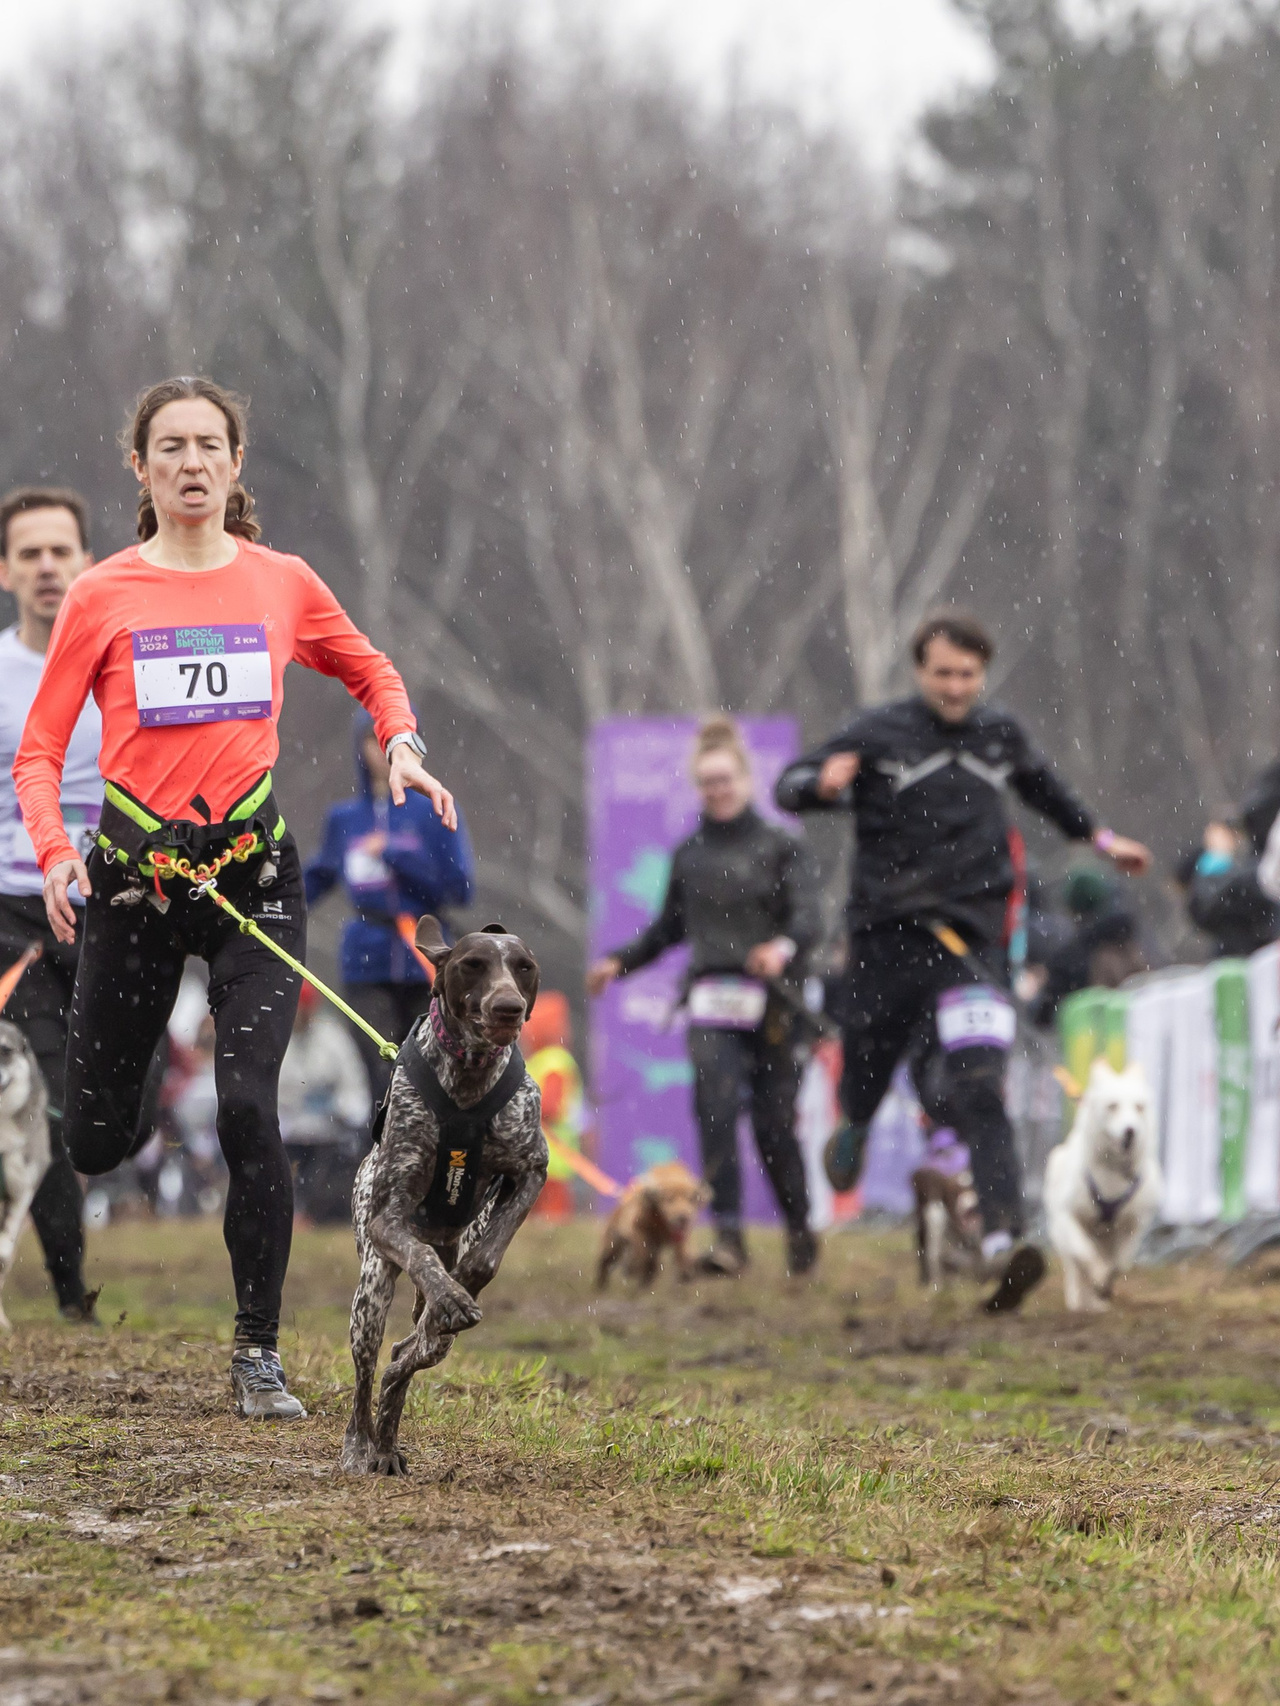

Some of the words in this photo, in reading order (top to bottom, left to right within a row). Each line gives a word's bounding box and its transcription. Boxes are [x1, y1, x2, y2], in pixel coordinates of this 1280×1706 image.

[139, 635, 168, 643] 11/04
[234, 636, 241, 645] 2
[140, 642, 169, 652] 2026
[179, 661, 228, 699] 70
[447, 1167, 465, 1206] Non-stop
